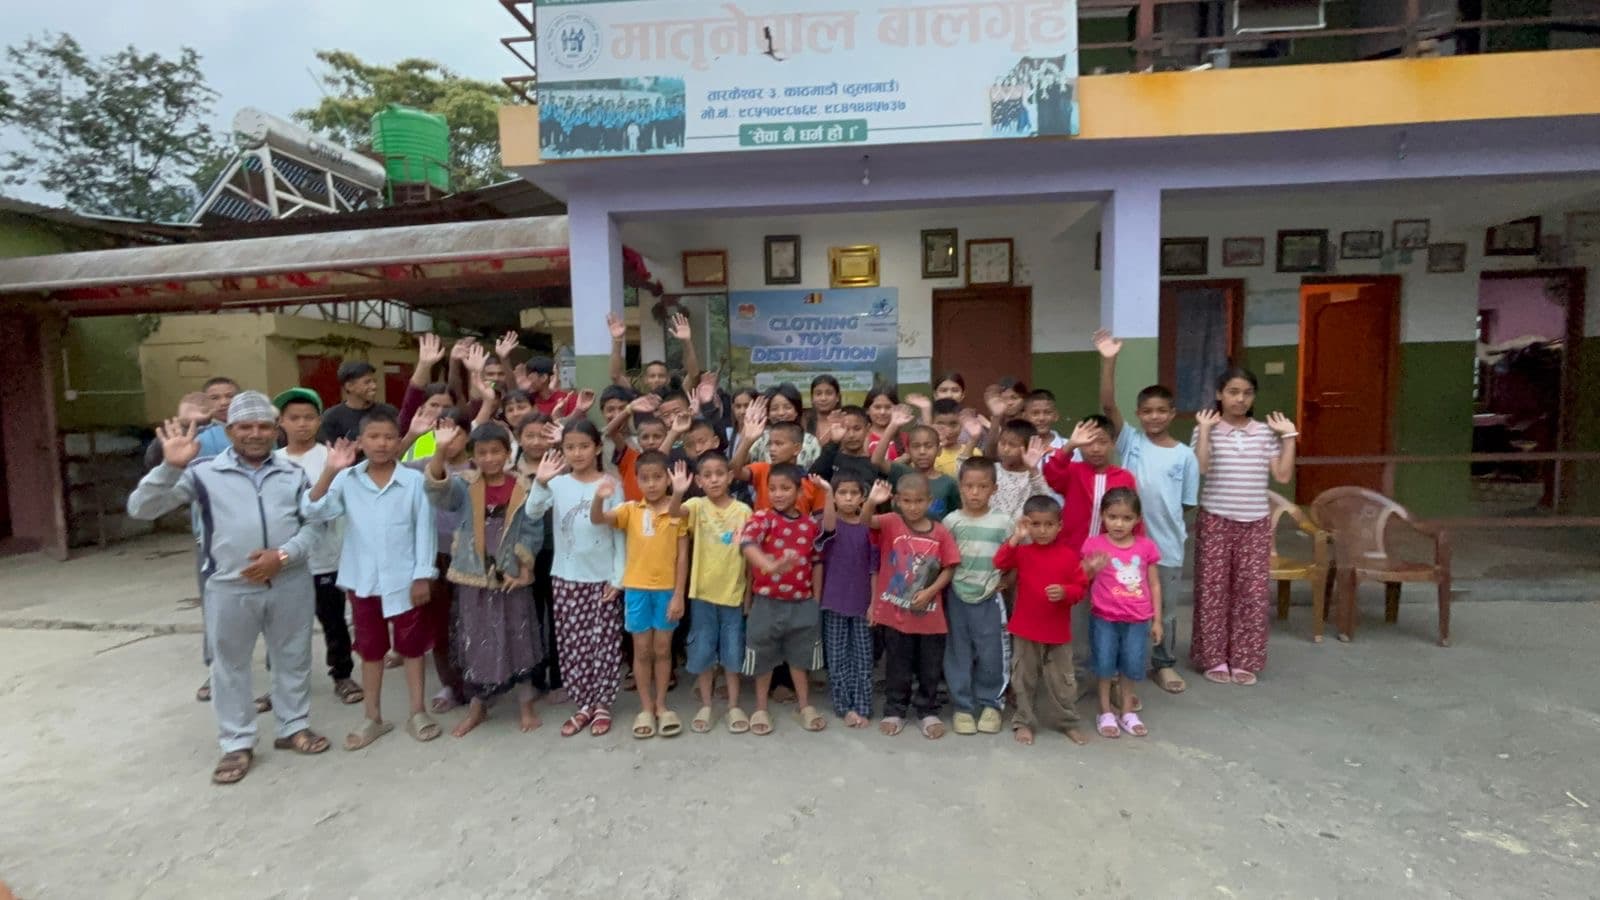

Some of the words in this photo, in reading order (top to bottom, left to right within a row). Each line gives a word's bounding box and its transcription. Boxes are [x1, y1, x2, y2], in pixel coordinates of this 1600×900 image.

[876, 0, 1068, 53] बालगृह
[769, 315, 859, 332] CLOTHING
[798, 331, 843, 346] TOYS
[752, 347, 878, 362] DISTRIBUTION
